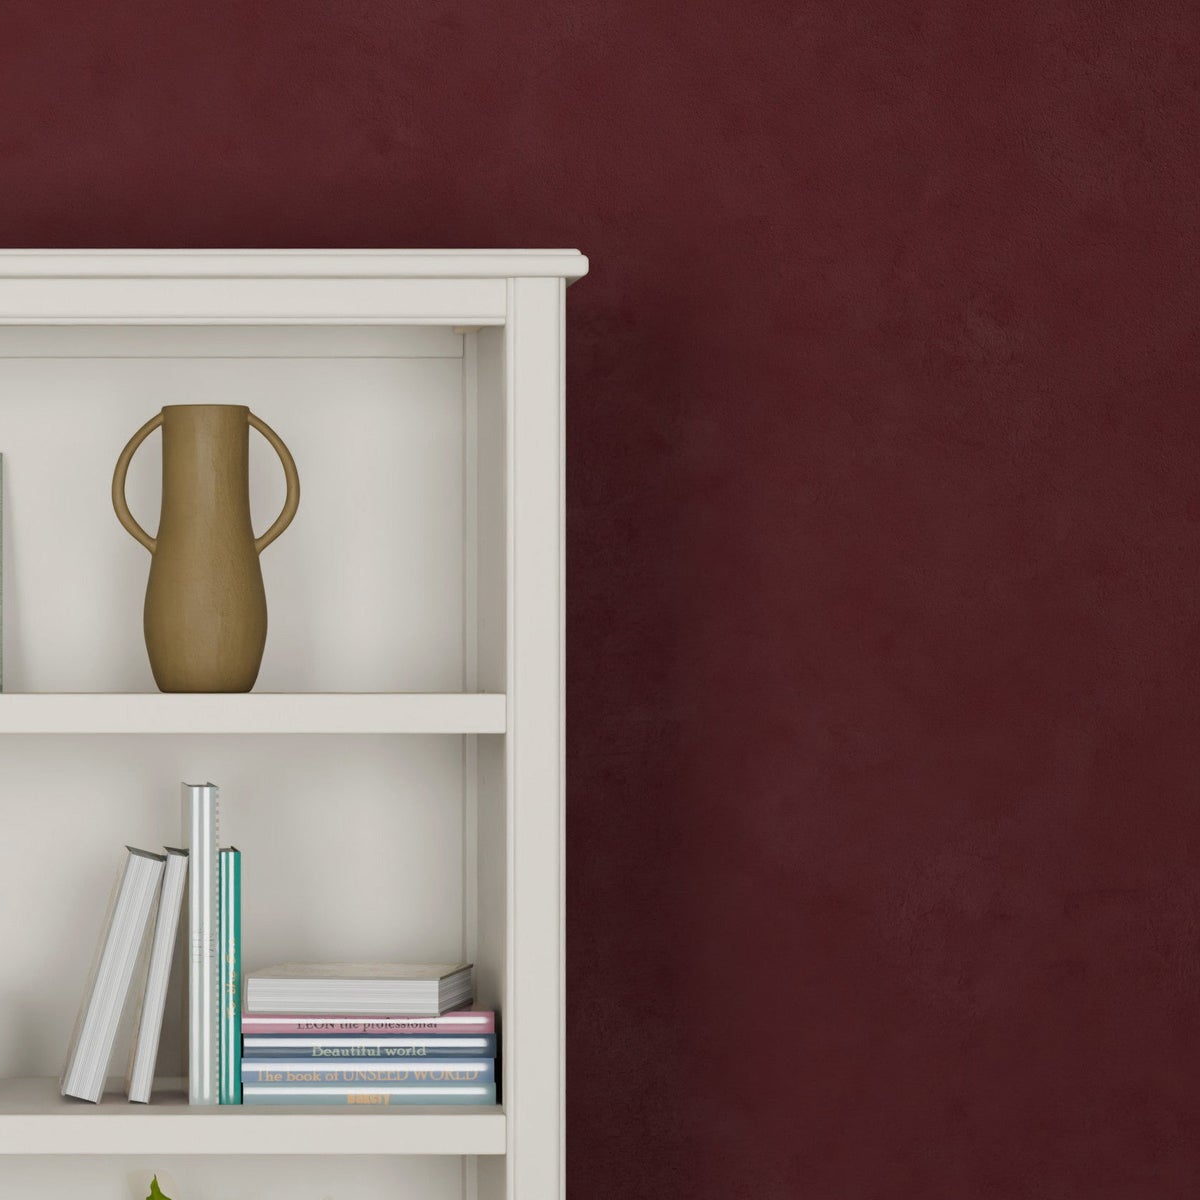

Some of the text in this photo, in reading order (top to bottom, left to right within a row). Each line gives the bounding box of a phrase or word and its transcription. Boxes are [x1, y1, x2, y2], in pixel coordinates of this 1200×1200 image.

[312, 1043, 426, 1056] Beautiful world
[257, 1070, 282, 1082] The
[286, 1070, 321, 1082] book
[326, 1070, 338, 1082] of
[414, 1070, 478, 1081] WORLD
